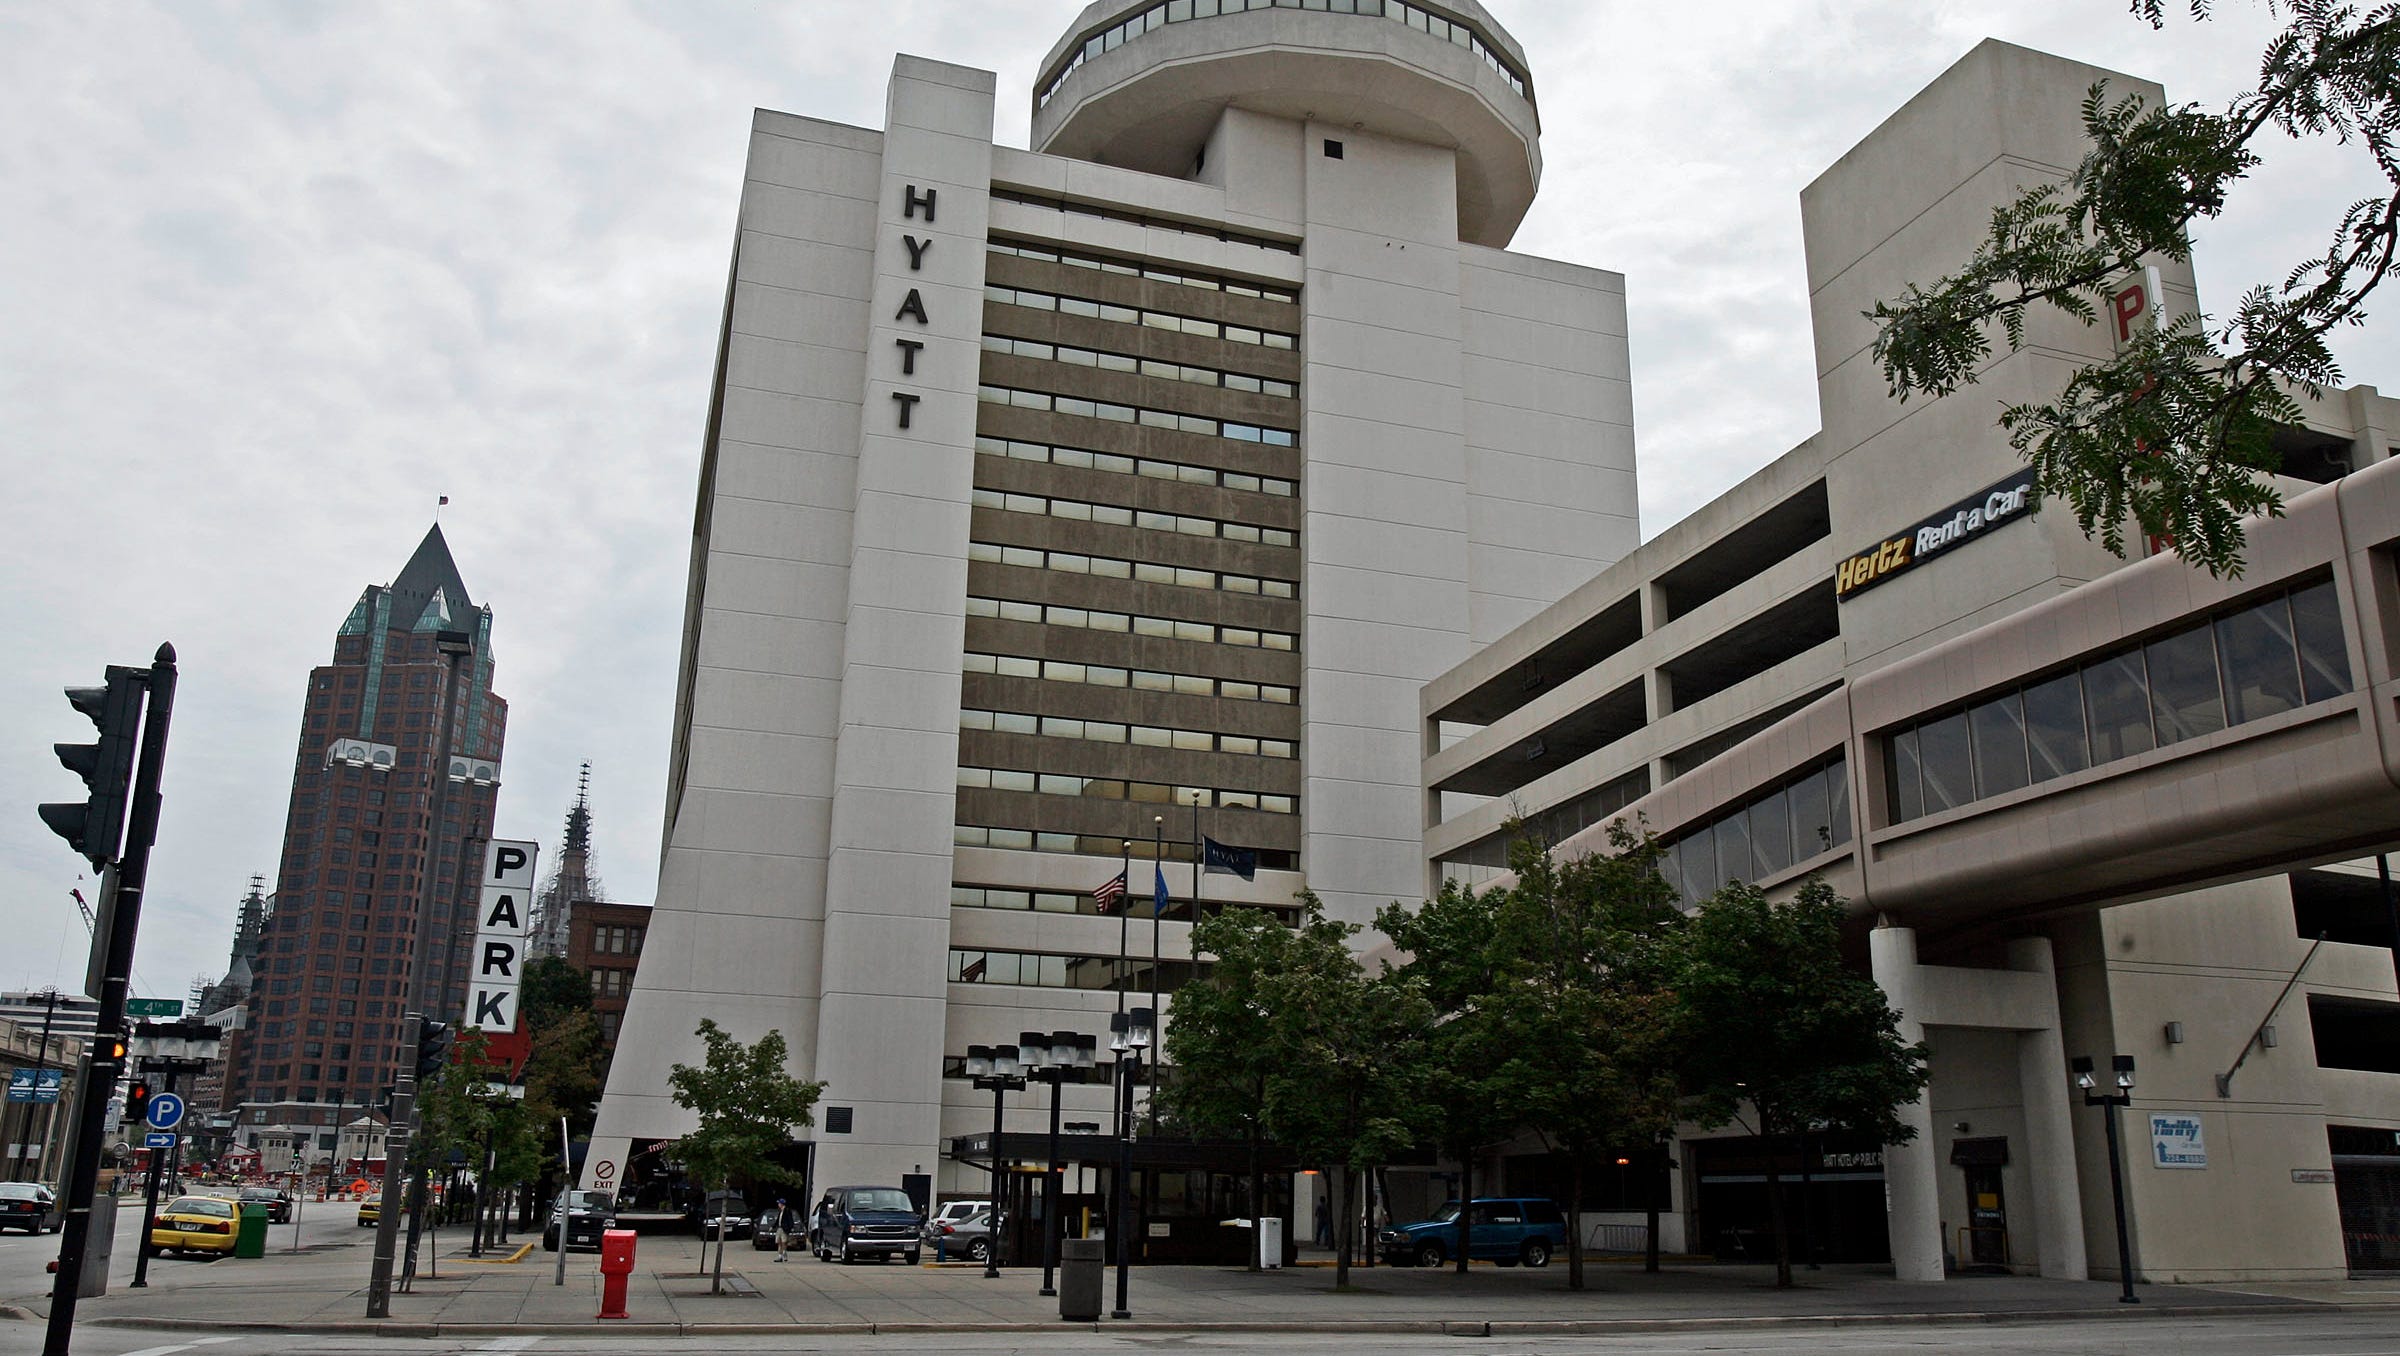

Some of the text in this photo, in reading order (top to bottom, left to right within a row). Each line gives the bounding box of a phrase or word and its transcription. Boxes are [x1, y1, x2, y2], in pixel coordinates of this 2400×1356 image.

[892, 184, 937, 429] HYATT
[1836, 484, 2031, 595] Hertz Rent a Car
[474, 846, 528, 1026] PARK
[144, 1001, 164, 1014] 4TH
[156, 1100, 175, 1122] P
[1837, 1153, 1853, 1167] HOTEL
[593, 1180, 615, 1189] EXIT
